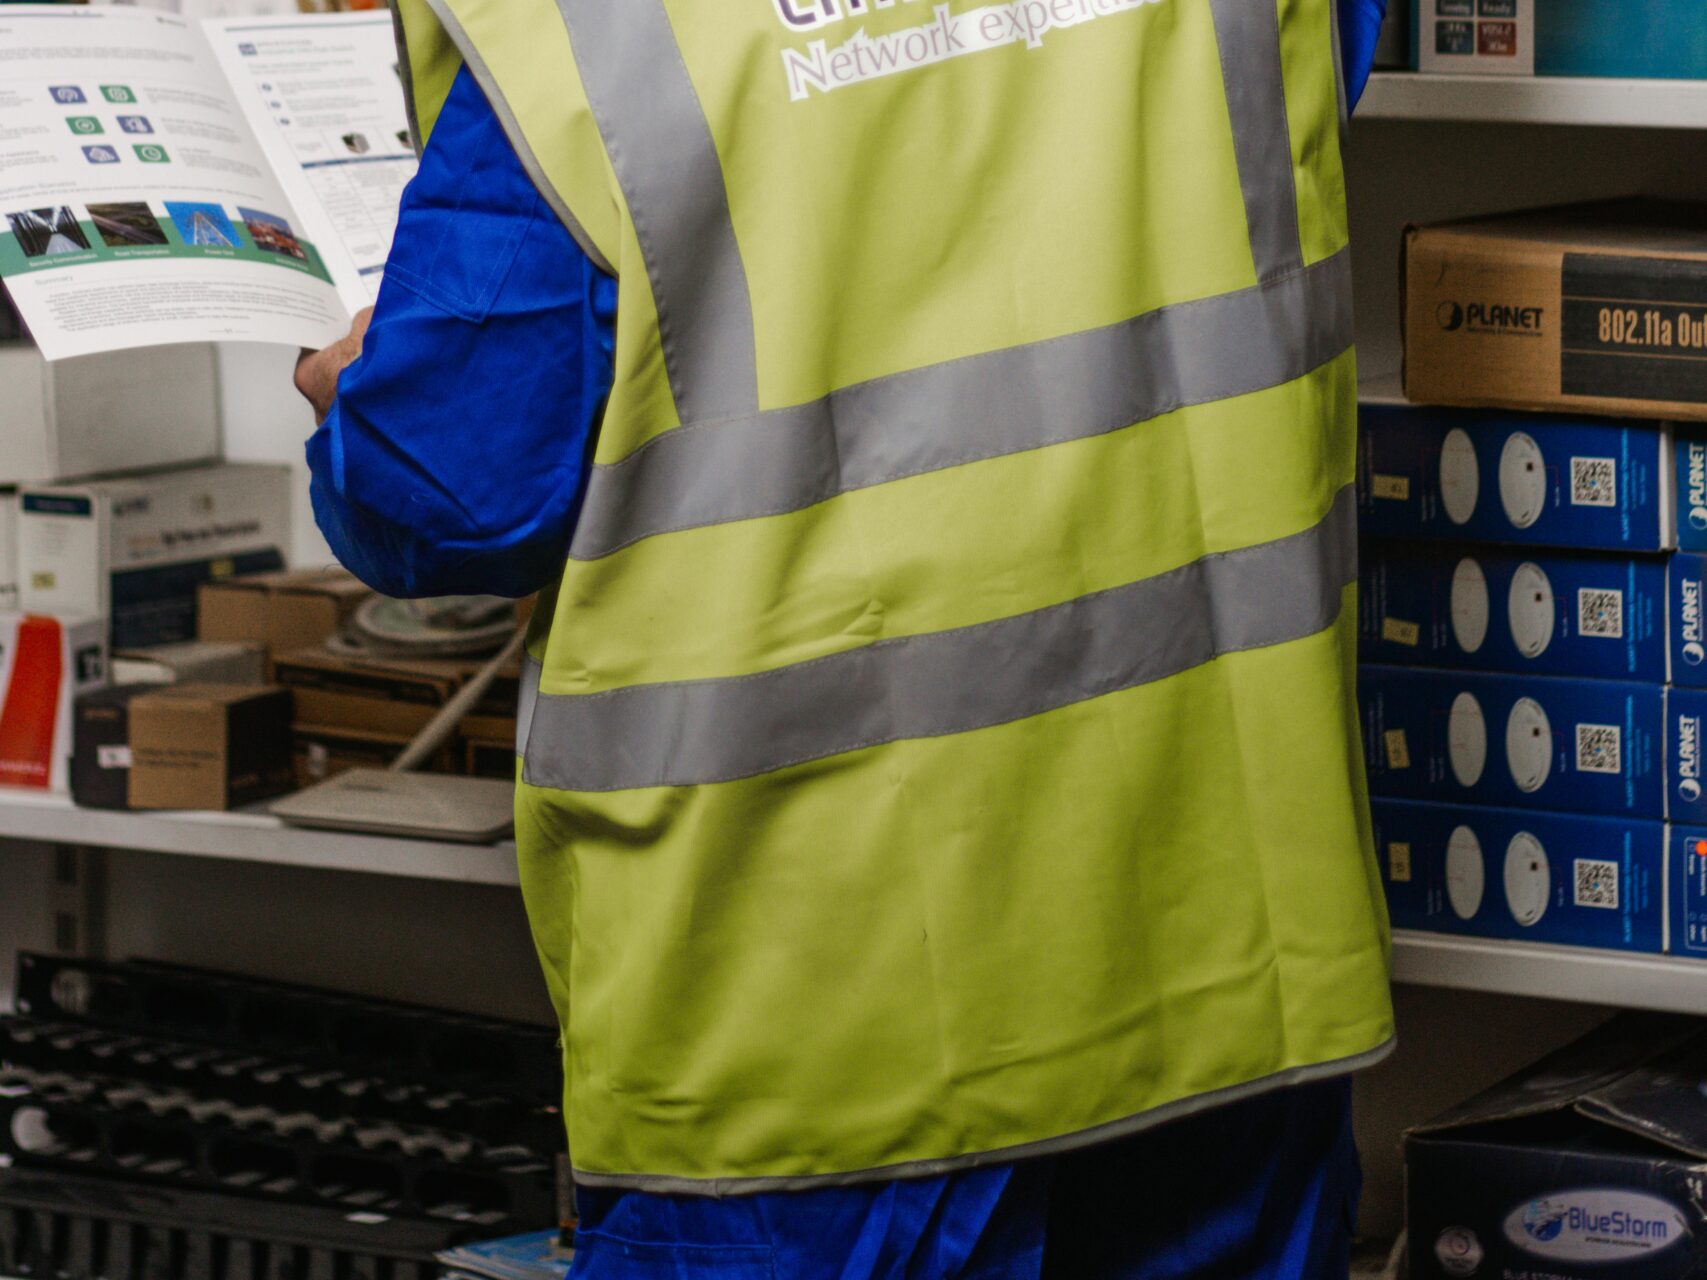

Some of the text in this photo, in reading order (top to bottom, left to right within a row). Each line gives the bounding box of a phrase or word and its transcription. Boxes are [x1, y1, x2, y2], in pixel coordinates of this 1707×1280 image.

[787, 10, 968, 94] Network
[1466, 303, 1544, 329] PLANET
[1598, 308, 1673, 347] 802.11a
[1688, 442, 1705, 507] PLANET
[1681, 577, 1698, 641] PLANET
[1679, 713, 1695, 778] PLANET
[1568, 1206, 1668, 1239] BlueStorm
